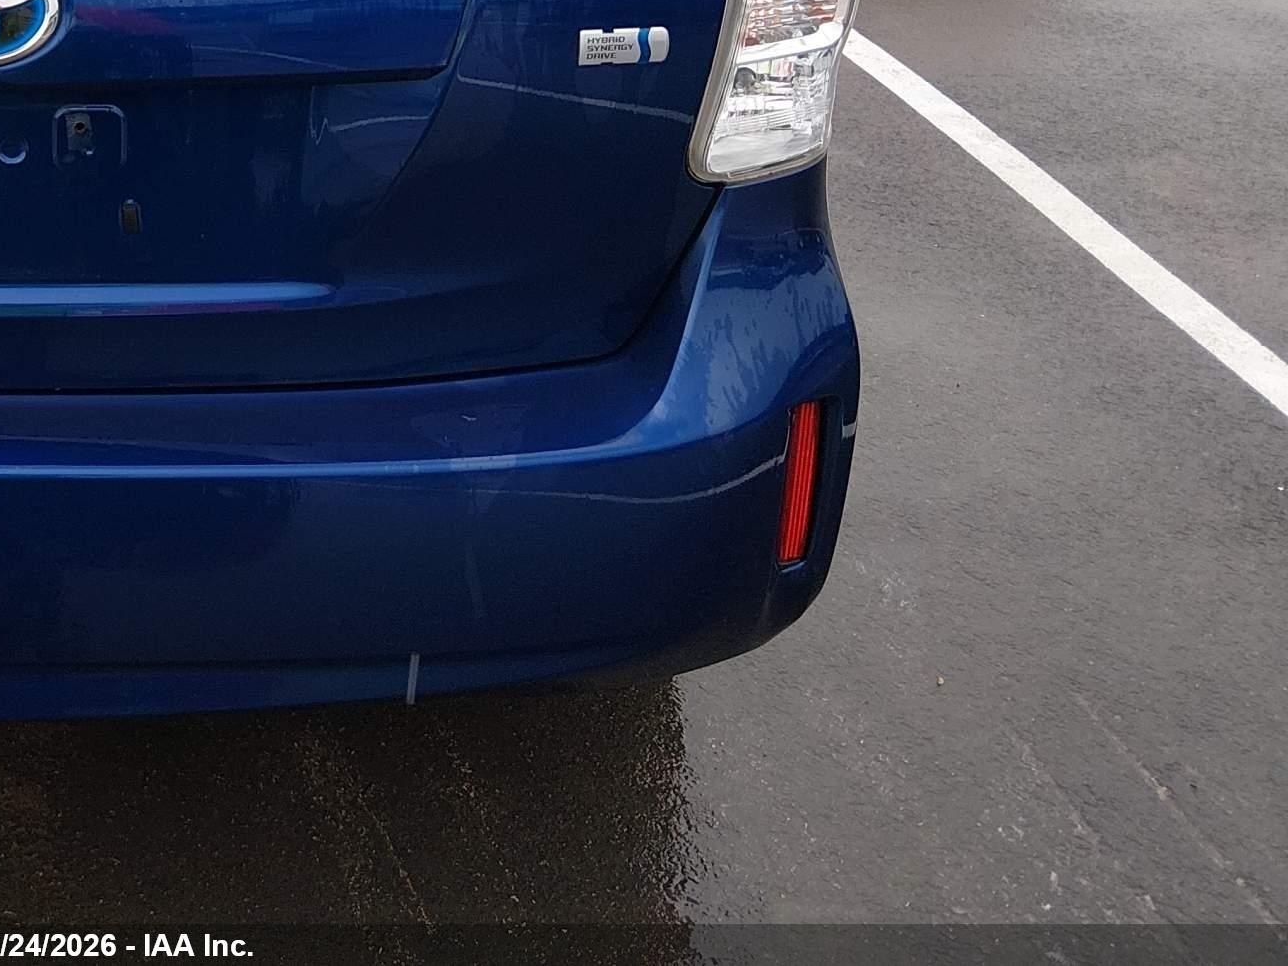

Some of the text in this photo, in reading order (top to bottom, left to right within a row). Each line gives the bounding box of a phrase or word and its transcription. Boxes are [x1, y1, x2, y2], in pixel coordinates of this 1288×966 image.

[586, 36, 626, 44] HYBRID
[586, 44, 634, 52] SYNERGY
[585, 52, 617, 60] DRIVE
